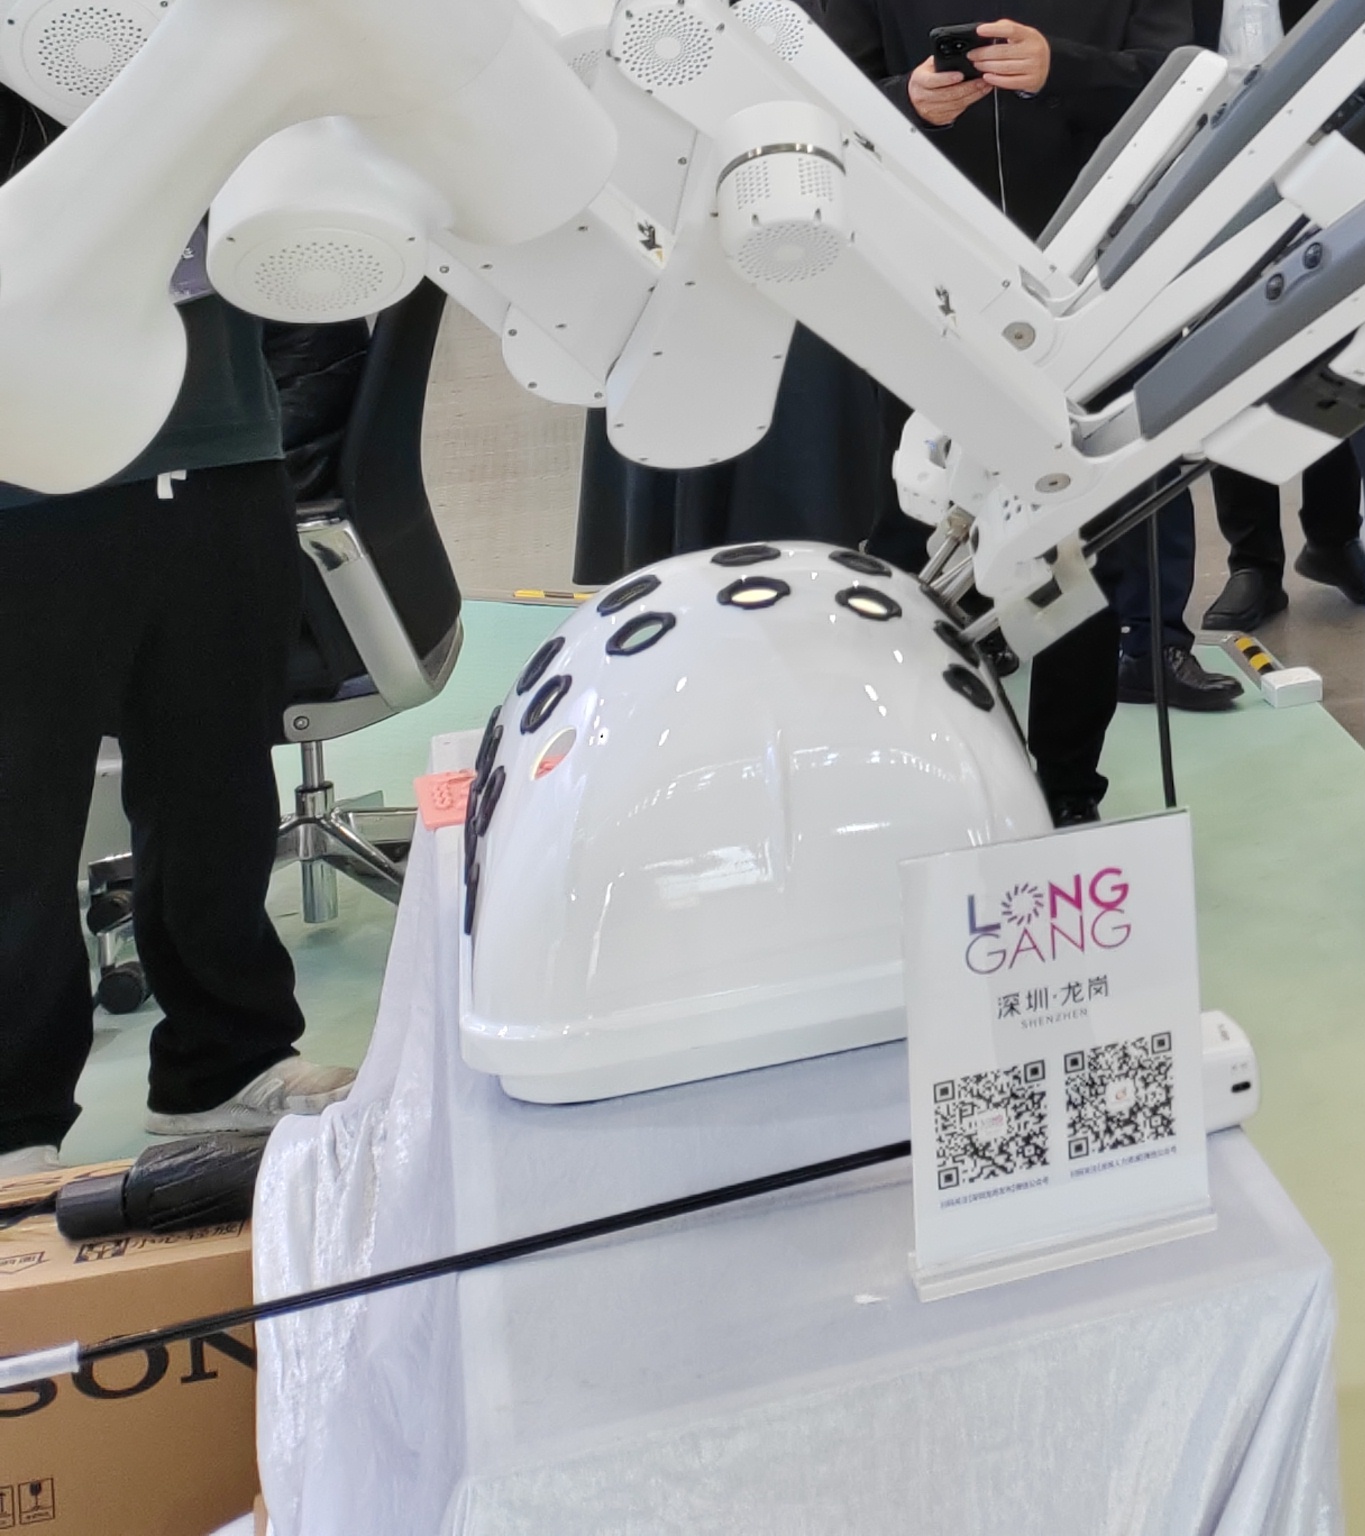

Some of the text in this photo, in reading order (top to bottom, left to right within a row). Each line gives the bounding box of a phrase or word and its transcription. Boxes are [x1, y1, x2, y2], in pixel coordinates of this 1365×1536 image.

[967, 867, 1130, 935] LONG
[965, 908, 1132, 975] GANG
[997, 974, 1109, 1019] 深圳·龙岗
[1021, 1008, 1088, 1029] SHENZHEN
